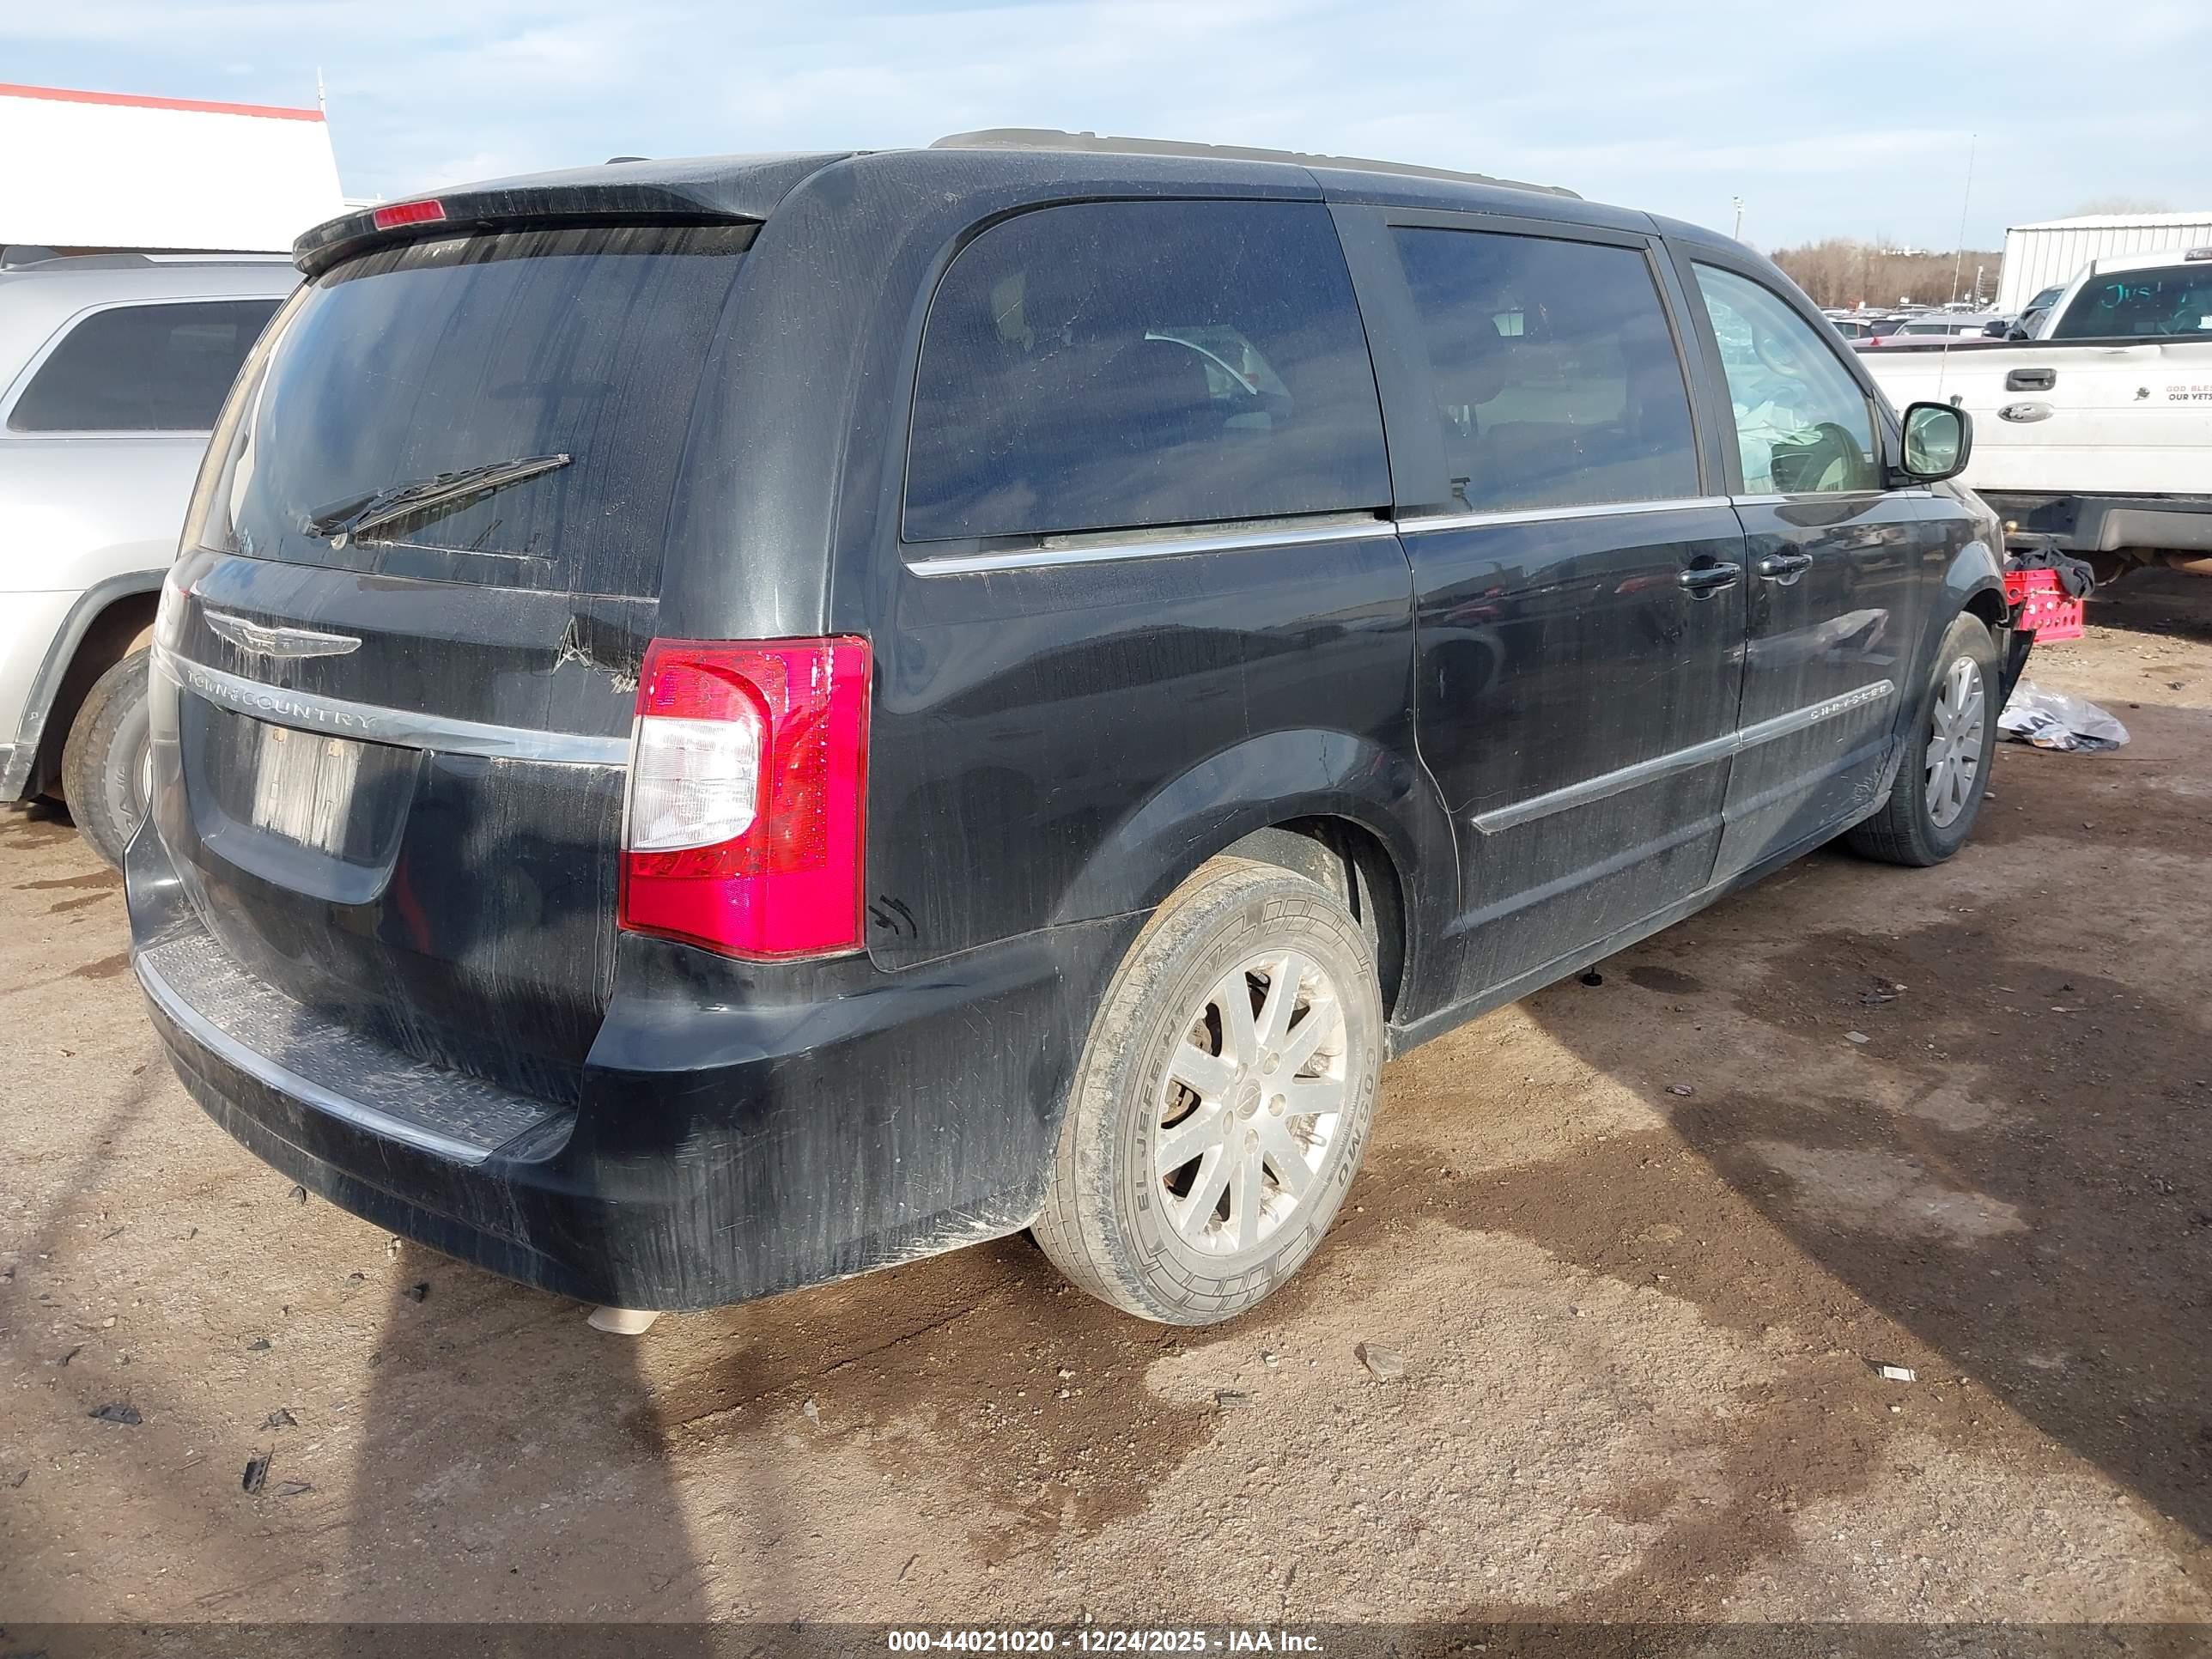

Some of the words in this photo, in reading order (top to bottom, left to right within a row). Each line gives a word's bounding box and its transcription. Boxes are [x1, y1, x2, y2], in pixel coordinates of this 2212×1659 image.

[187, 669, 228, 697] TOWN
[243, 691, 377, 729] COUNTRY
[1810, 684, 1887, 720] CHRYSLER
[1136, 1060, 1162, 1158] JEFE
[1338, 1047, 1376, 1188] COSMO
[1136, 1170, 1151, 1212] EL
